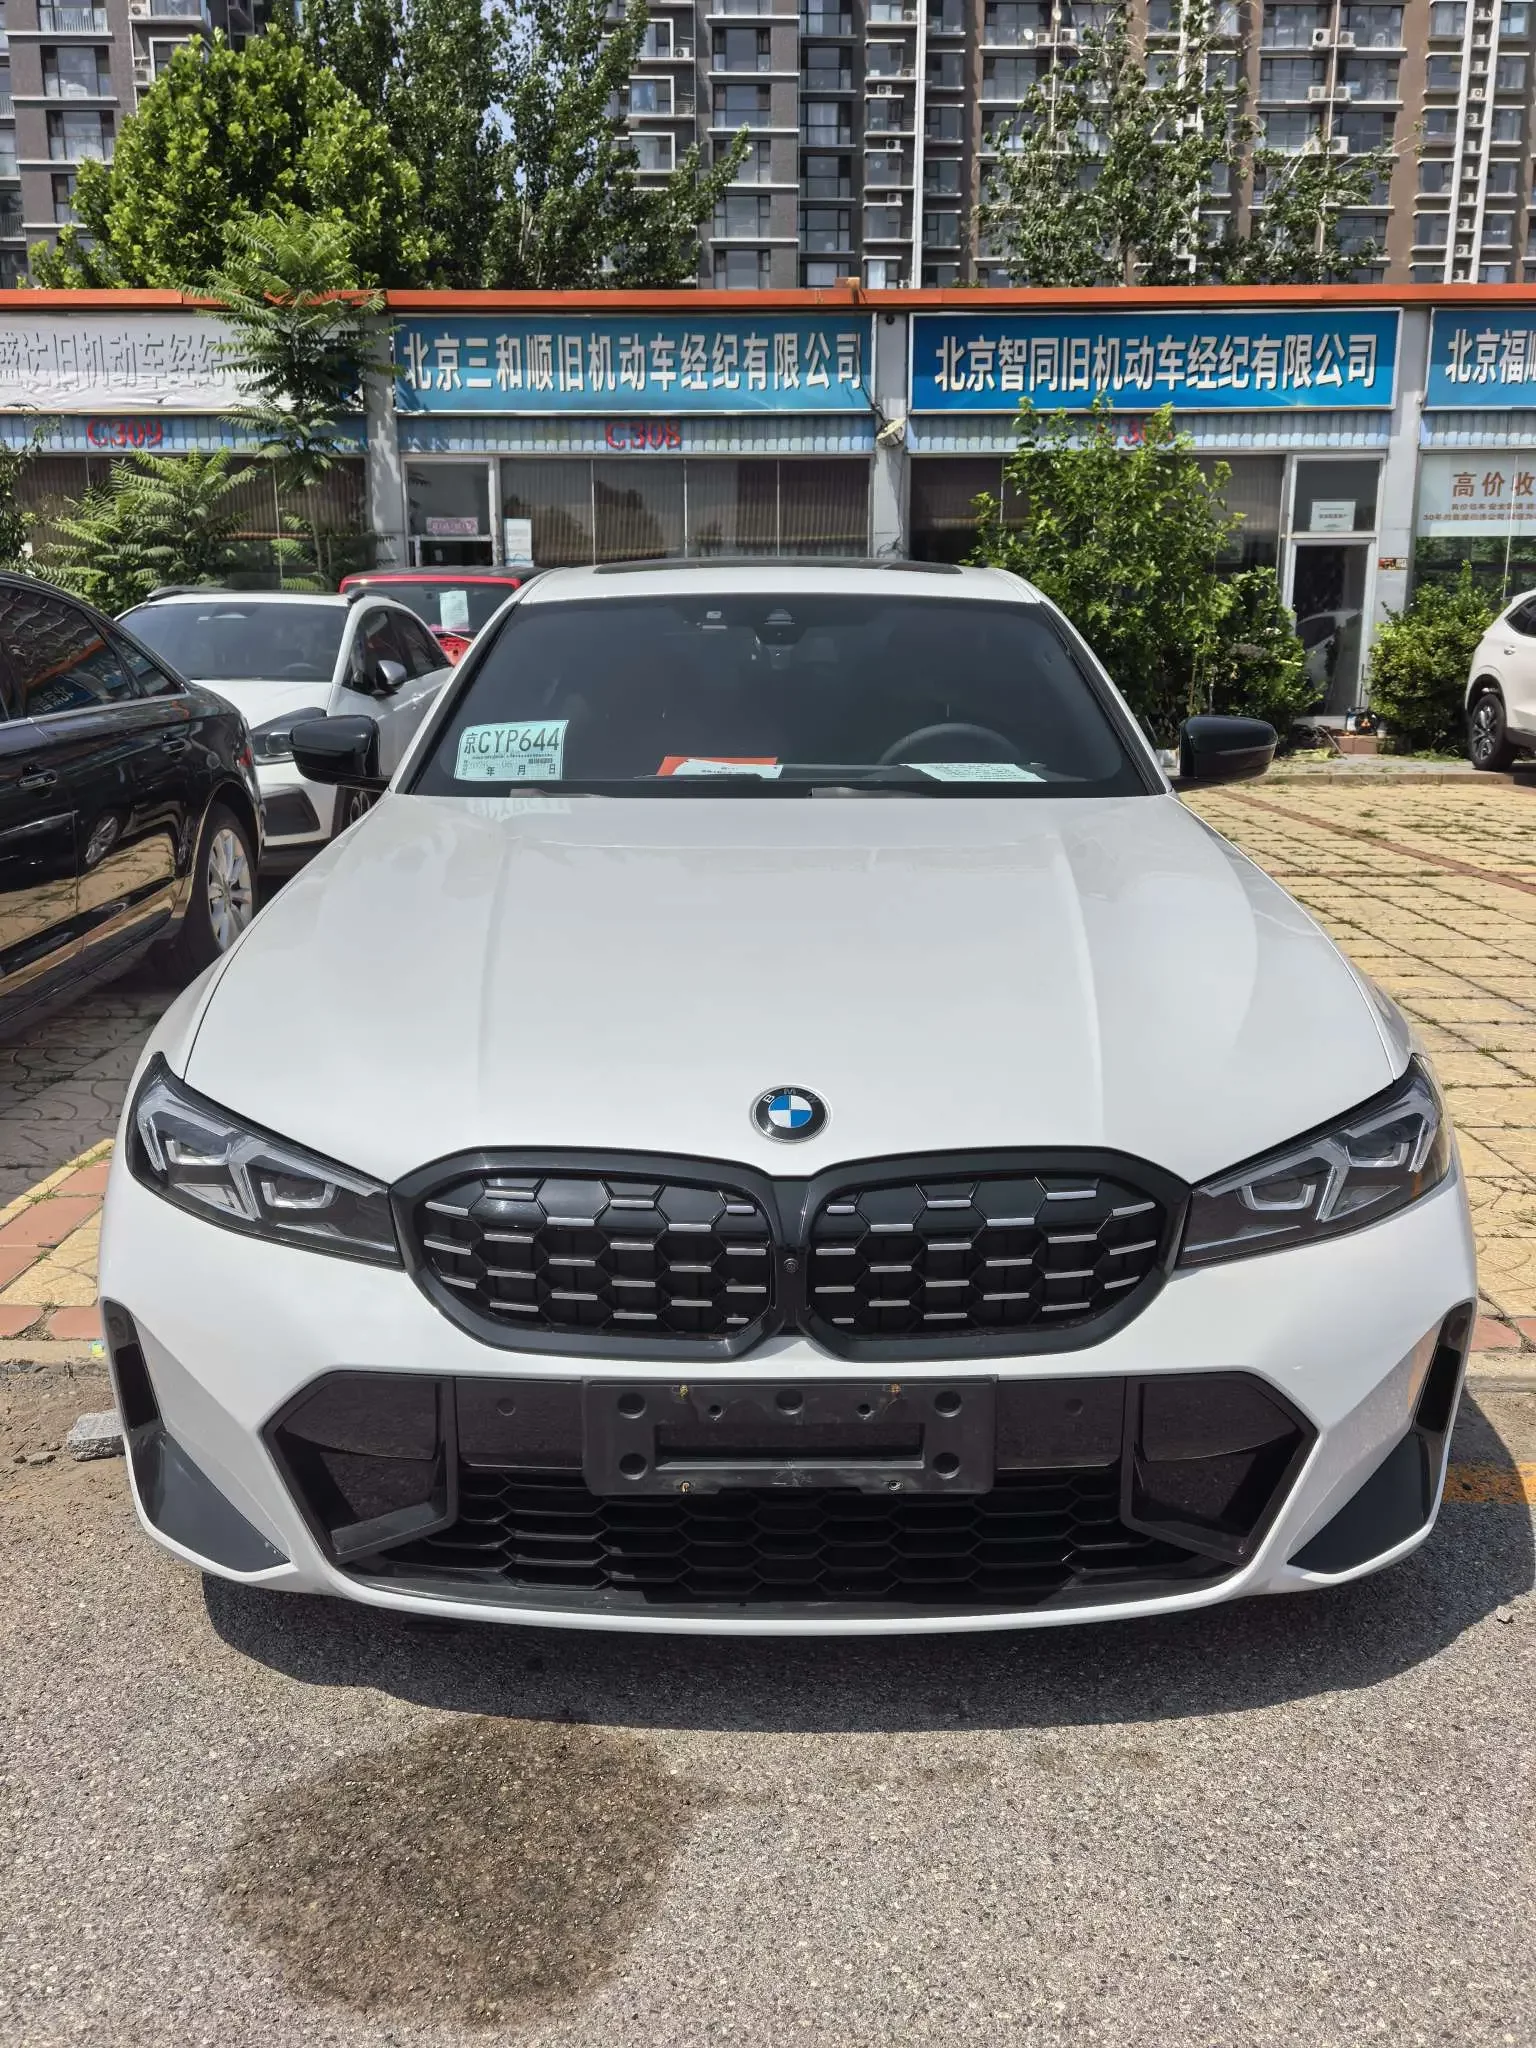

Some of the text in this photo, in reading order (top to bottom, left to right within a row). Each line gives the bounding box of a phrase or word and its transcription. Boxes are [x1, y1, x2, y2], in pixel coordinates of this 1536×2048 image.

[403, 331, 863, 392] 北京三和顺旧机动车经纪有限公司
[934, 332, 1378, 393] 北京智同旧机动车经纪有限公司
[86, 418, 164, 448] C309
[604, 417, 682, 451] C308
[463, 727, 560, 754] 京CYP644
[486, 766, 496, 776] 年
[517, 764, 526, 776] 月
[548, 763, 556, 775] 日
[763, 1087, 820, 1104] BMW
